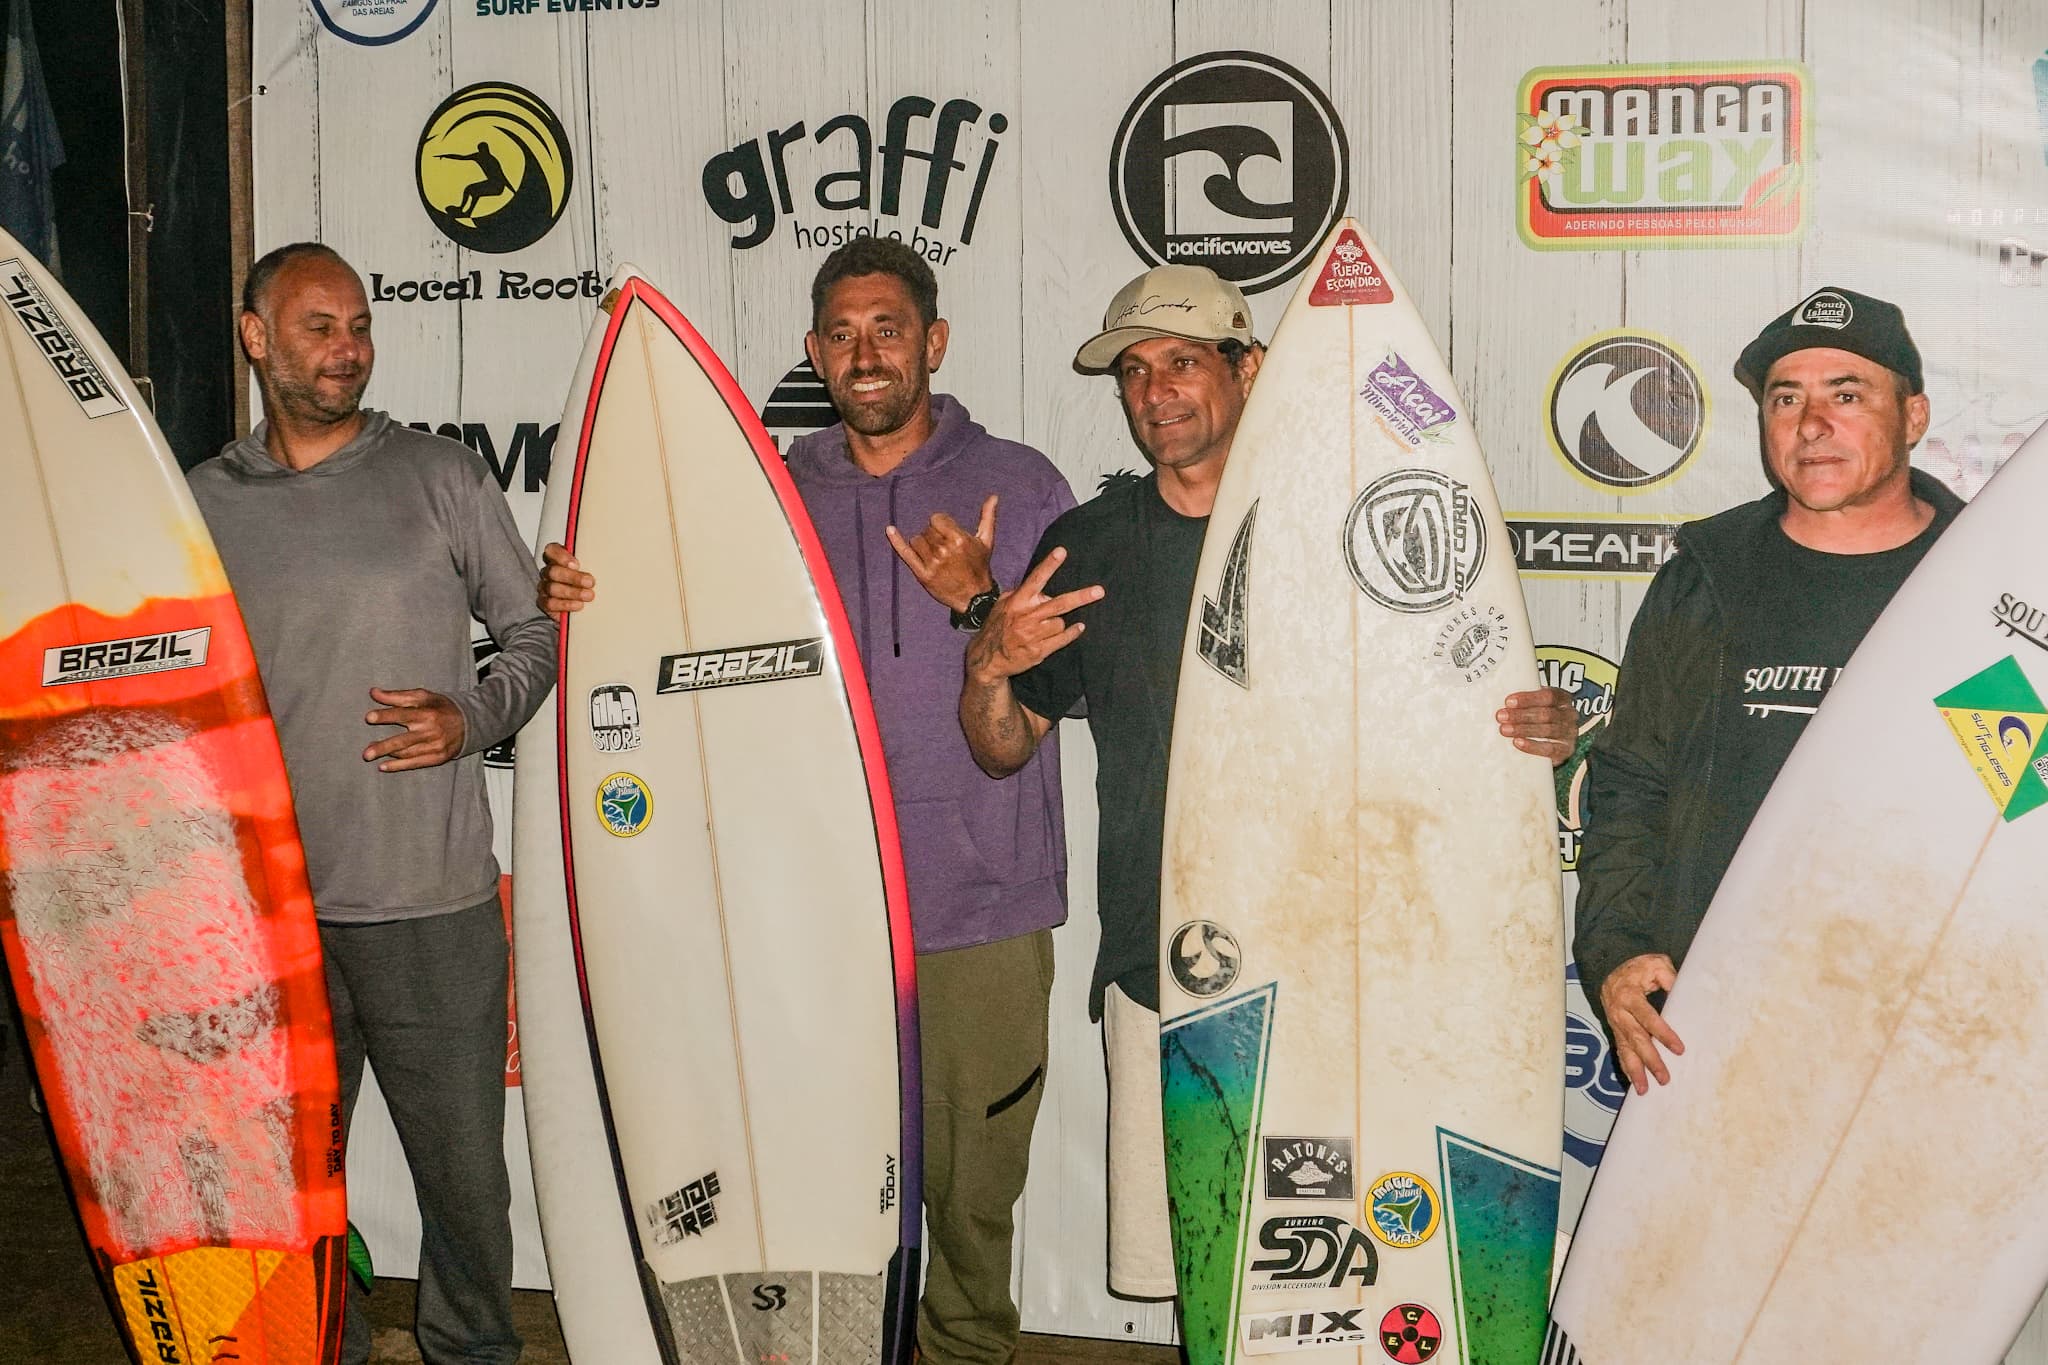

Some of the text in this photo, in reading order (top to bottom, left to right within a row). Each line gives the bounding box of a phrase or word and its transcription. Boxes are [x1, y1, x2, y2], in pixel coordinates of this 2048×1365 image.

[352, 8, 368, 16] DAS
[476, 0, 540, 16] SURF
[702, 95, 1008, 249] graffi
[1565, 219, 1625, 231] ADERINDO
[1628, 218, 1682, 230] PESSOAS
[911, 226, 957, 266] bar
[1166, 236, 1292, 260] pacificwaves
[1331, 261, 1373, 277] PUERTO
[369, 270, 483, 302] Local
[1326, 276, 1382, 292] ESCONDIDO
[1807, 308, 1845, 317] Island
[1815, 301, 1846, 309] South
[1993, 592, 2048, 640] SOU
[1744, 666, 1828, 693] SOUTH
[593, 725, 641, 751] STORE
[602, 776, 634, 796] MAGIC
[610, 821, 639, 835] WAX
[1272, 1142, 1348, 1173] RATONES
[886, 1153, 896, 1210] TODAY
[1372, 1176, 1414, 1200] MAGIC
[1284, 1218, 1325, 1227] SURFING
[1386, 1230, 1424, 1244] WAX
[1251, 1216, 1379, 1288] SDA
[1251, 1281, 1327, 1291] DIVISION ACCESSORIES
[137, 1269, 181, 1365] RAZIL
[1249, 1308, 1366, 1340] MIX
[1297, 1333, 1366, 1346] FINS
